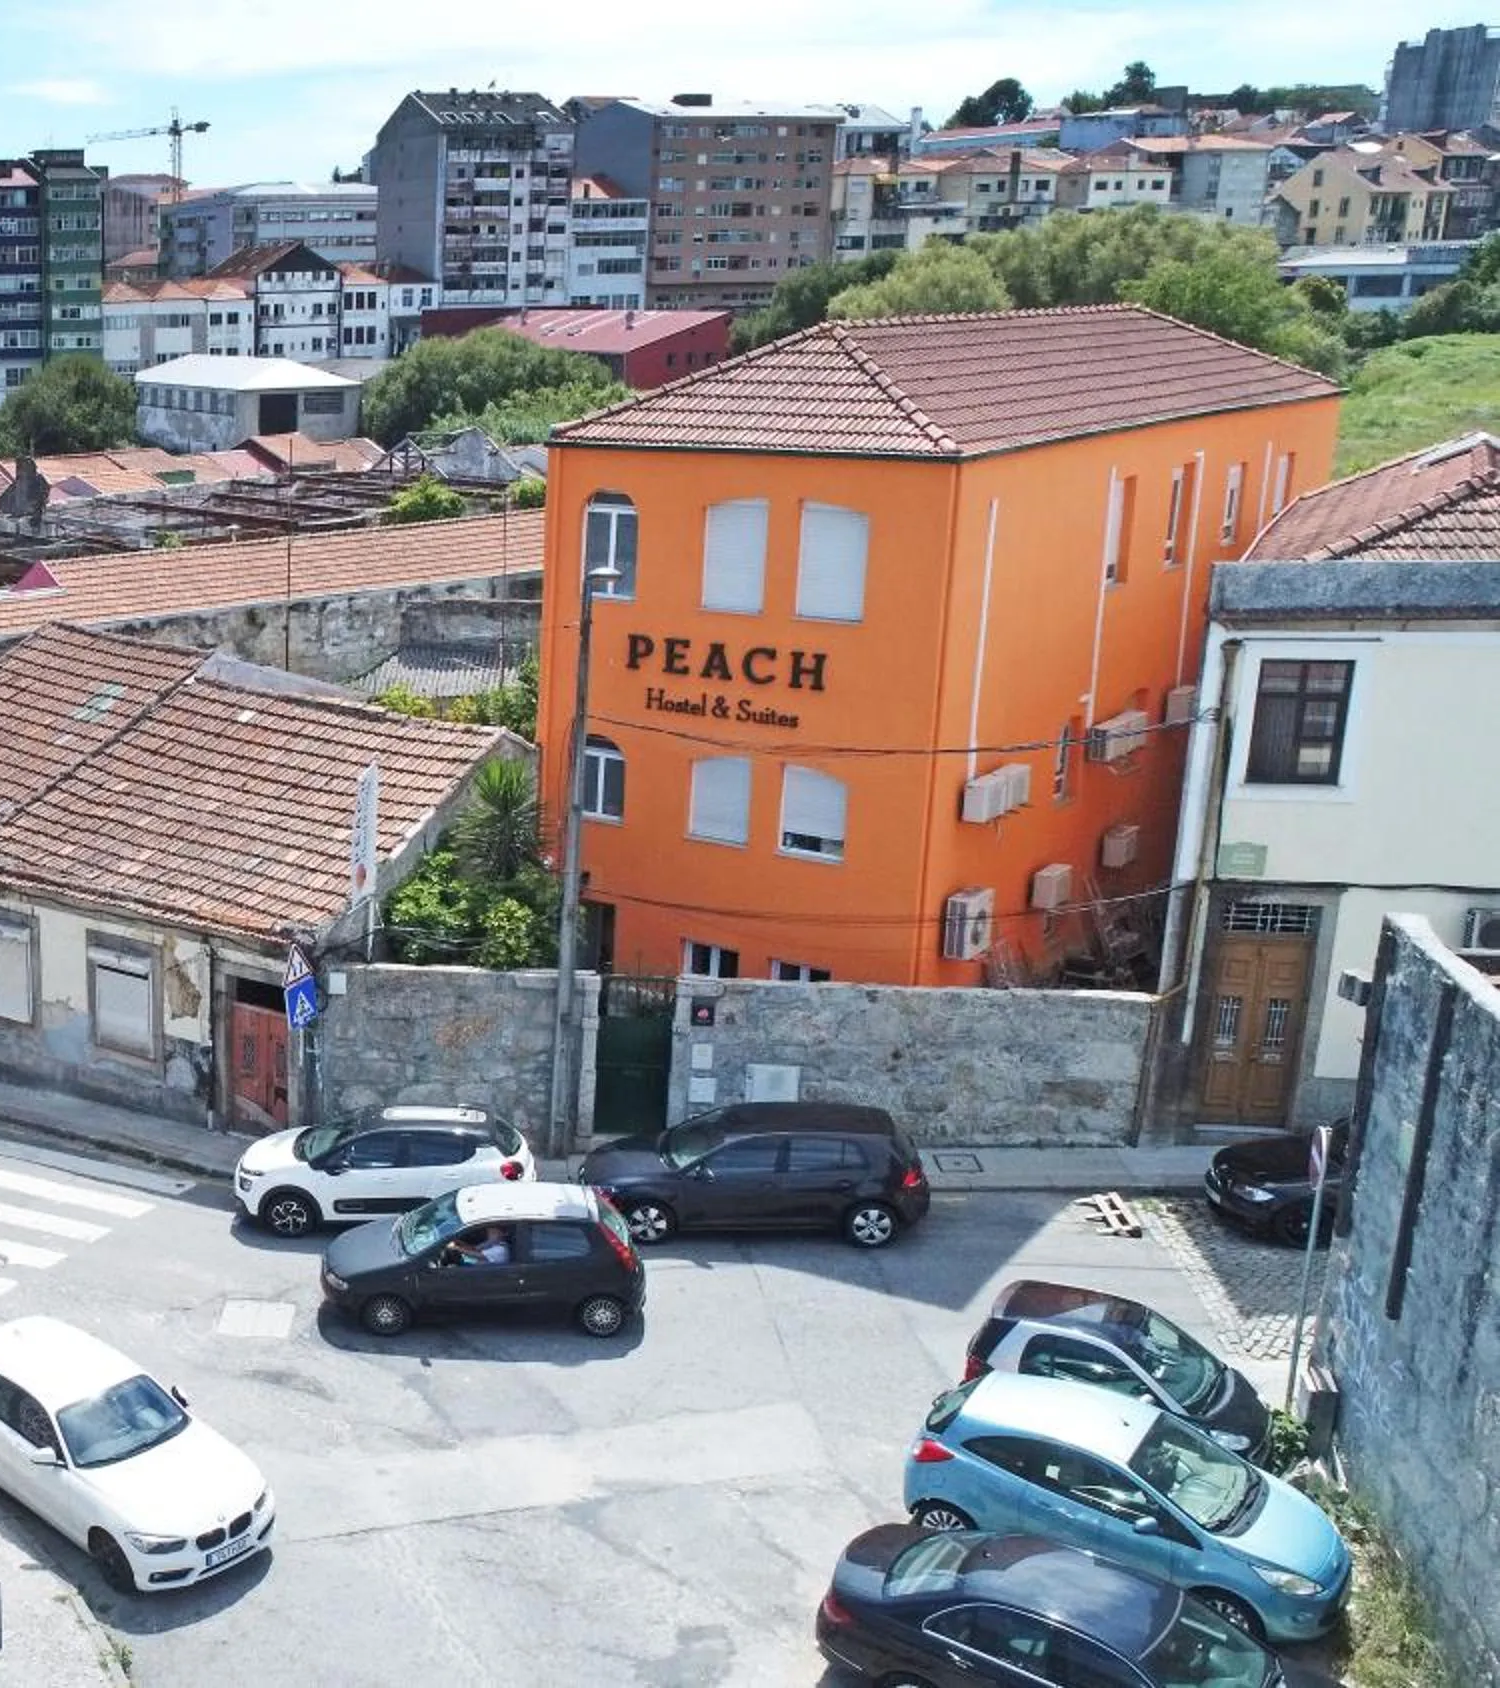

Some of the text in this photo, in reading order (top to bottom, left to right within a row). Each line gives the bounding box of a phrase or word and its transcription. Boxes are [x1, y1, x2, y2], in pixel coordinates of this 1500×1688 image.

[625, 633, 827, 691] PEACH
[645, 687, 799, 728] Hostel & Suites
